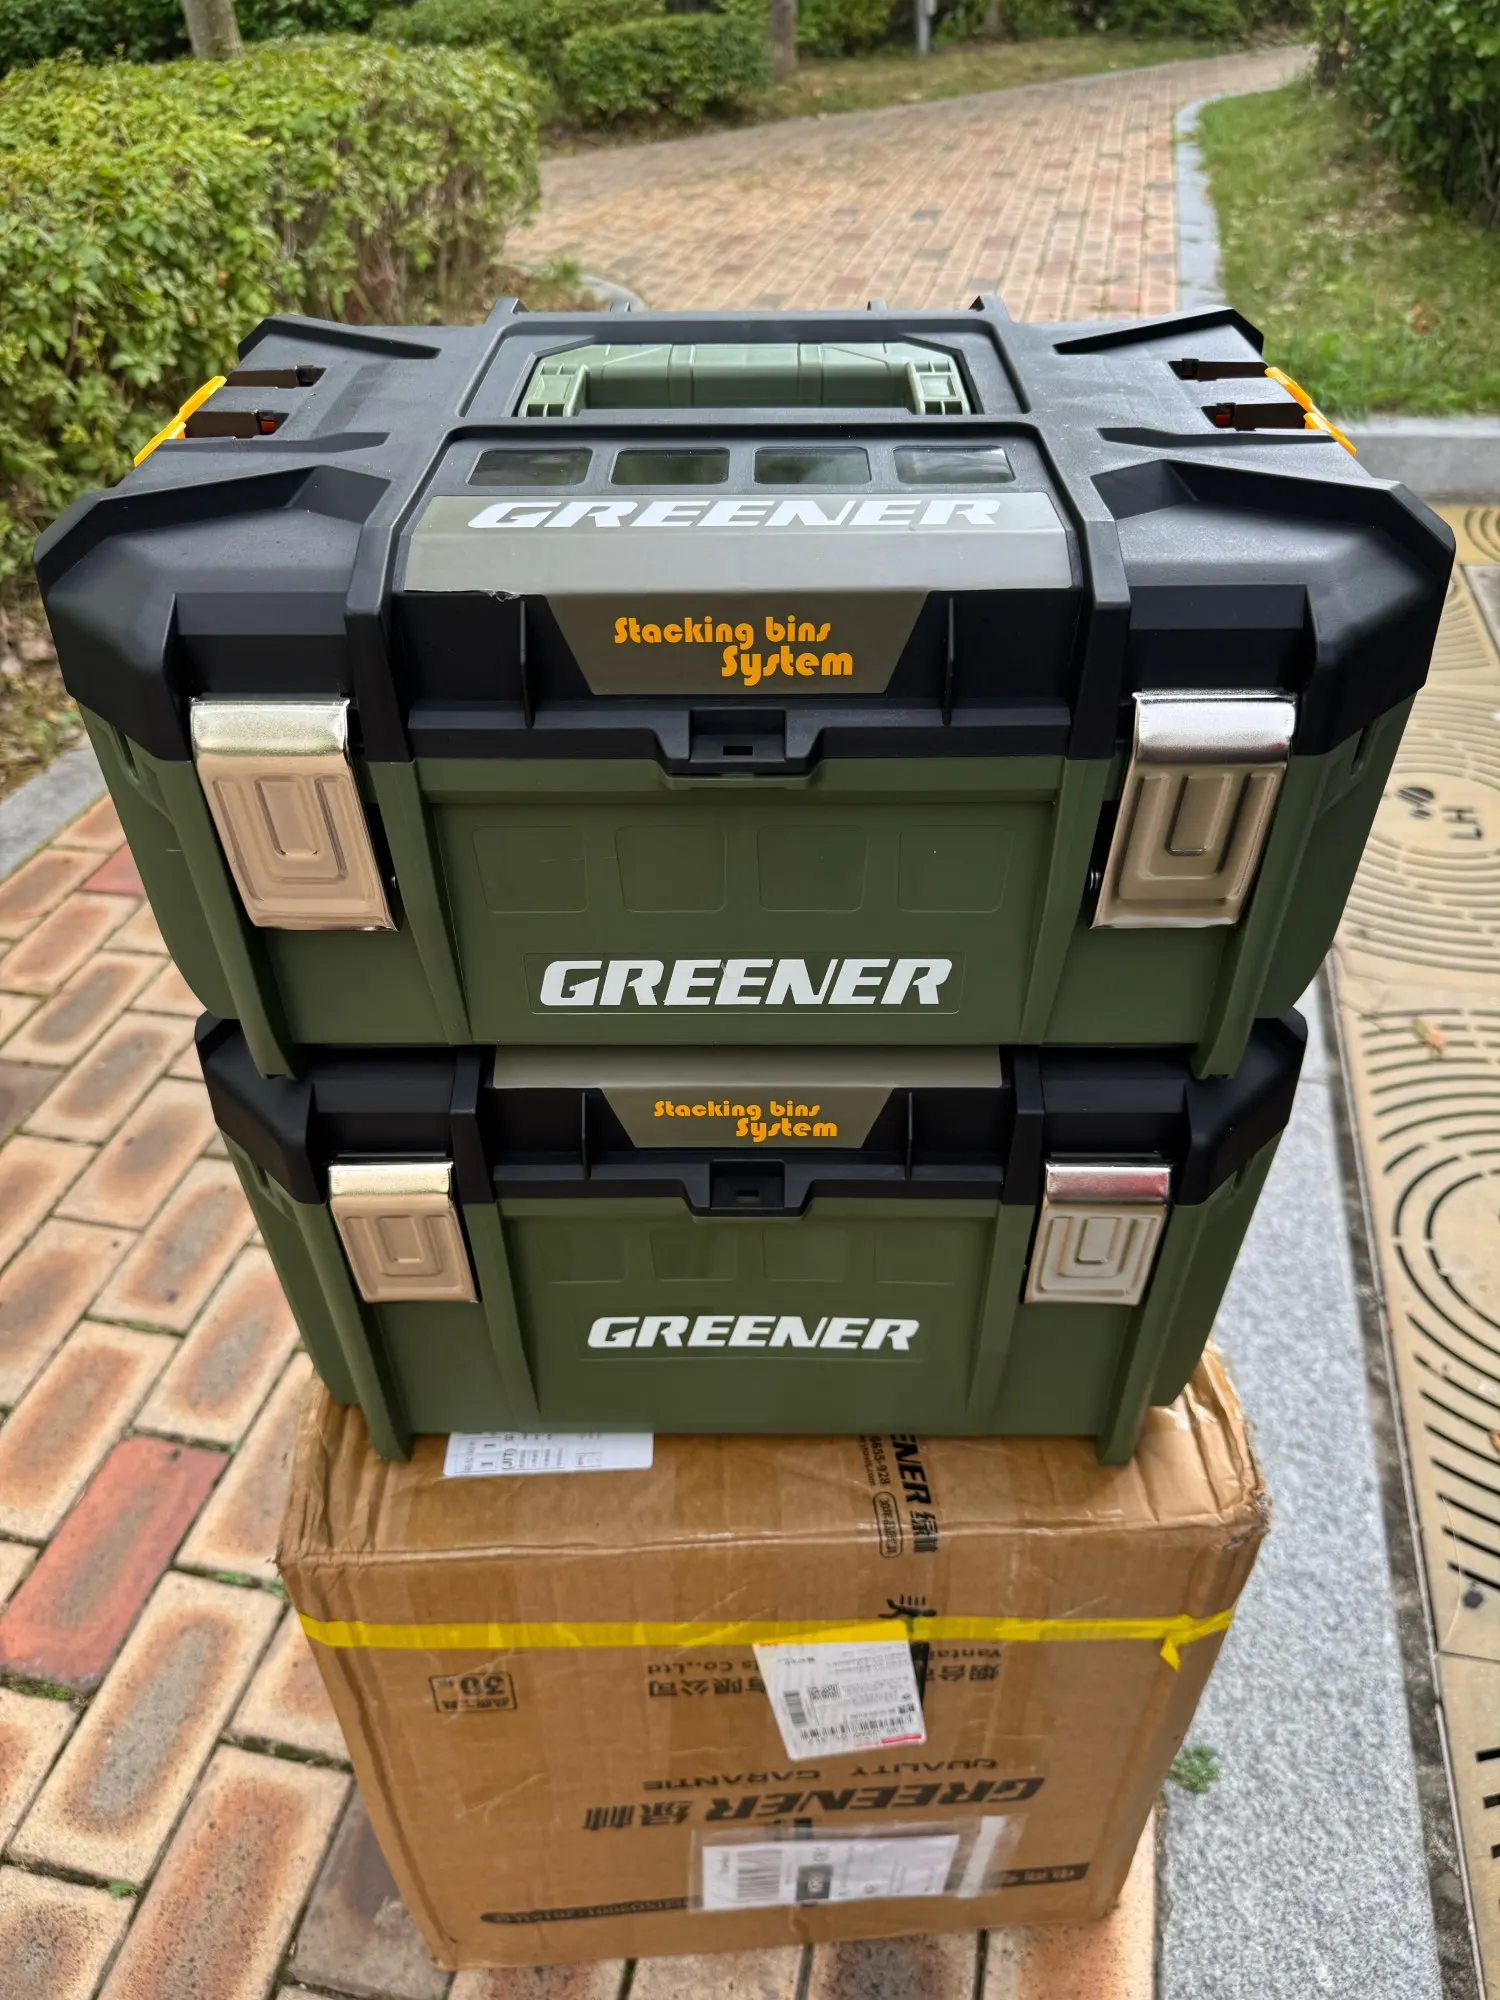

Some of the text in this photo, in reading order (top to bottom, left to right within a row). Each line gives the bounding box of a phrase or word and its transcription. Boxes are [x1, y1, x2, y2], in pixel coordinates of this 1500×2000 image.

[467, 498, 1001, 529] GREENER
[614, 616, 831, 651] Stacking bins
[722, 643, 854, 687] System
[540, 958, 952, 1006] GREENER
[653, 1100, 821, 1121] Stacking bins
[735, 1117, 838, 1142] System
[587, 1315, 919, 1351] GREENER
[850, 1757, 998, 1780] QUALITY
[703, 1777, 1046, 1821] GREENER
